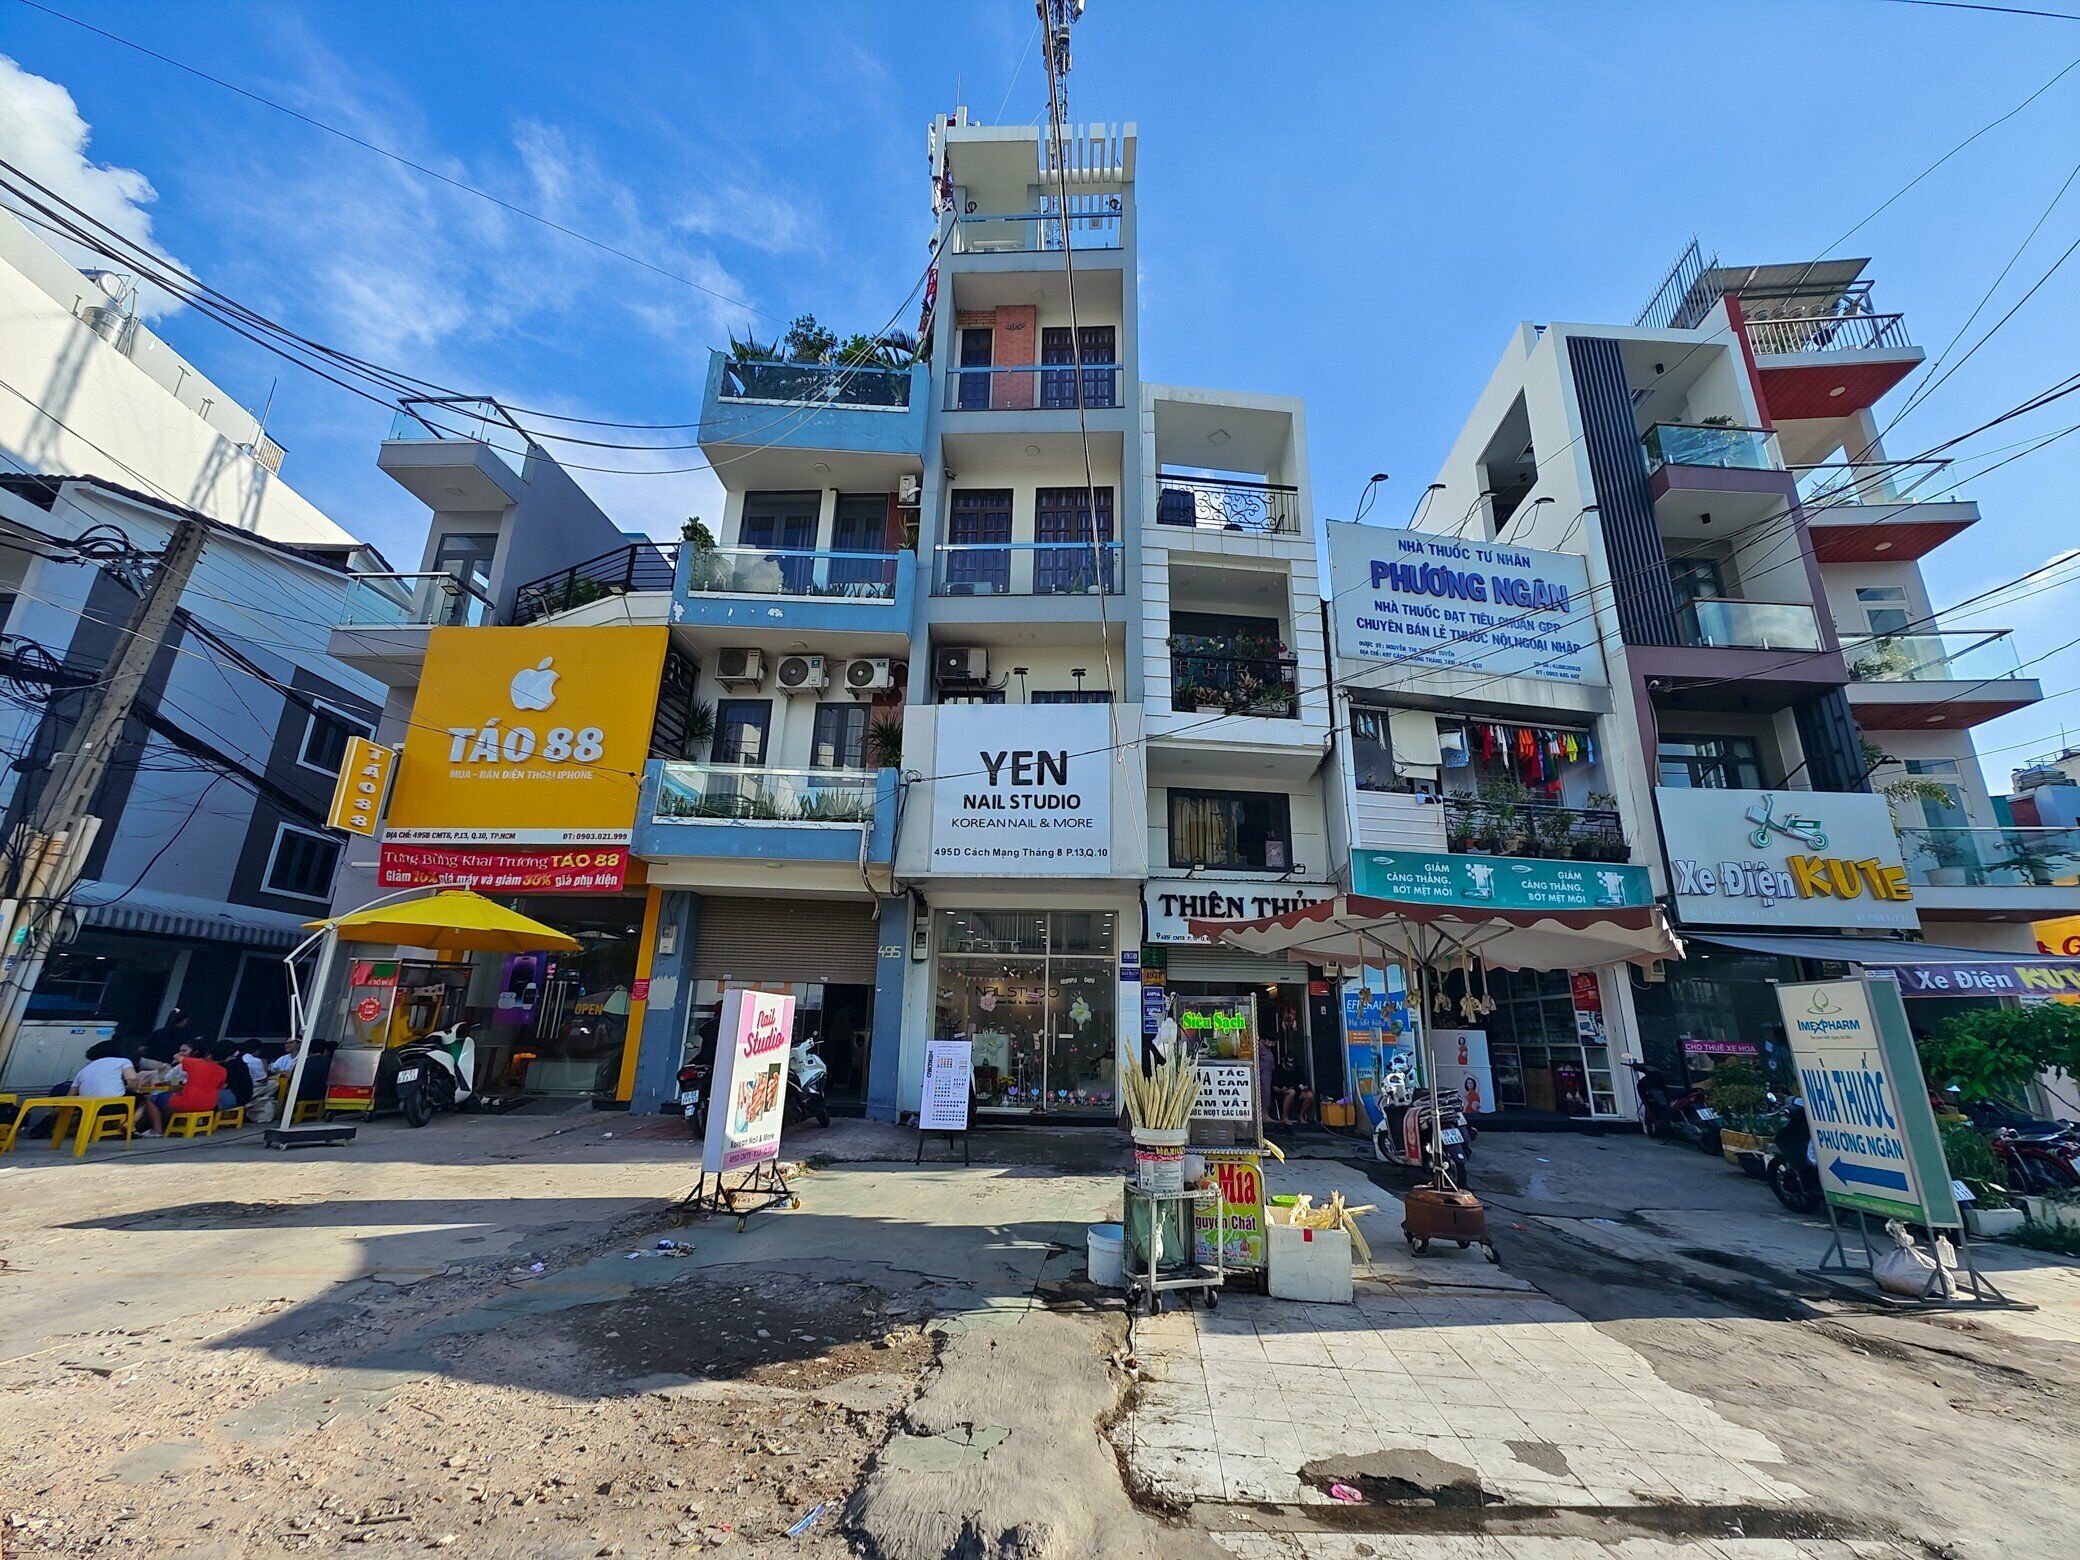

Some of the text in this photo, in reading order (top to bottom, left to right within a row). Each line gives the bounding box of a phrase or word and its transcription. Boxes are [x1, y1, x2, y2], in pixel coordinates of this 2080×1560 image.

[1398, 539, 1531, 568] NHÀ THUỐC TƯ NHÂN
[1370, 560, 1570, 612] PHƯƠNG NGÂN
[1374, 600, 1399, 614] NHÀ
[1402, 603, 1440, 619] THUỐC
[1444, 610, 1466, 624] ĐẠT
[1469, 611, 1494, 625] TIÊU
[1356, 616, 1403, 633] CHUYÊN
[1406, 622, 1430, 637] BÁN
[1433, 624, 1447, 639] LẺ
[448, 717, 604, 763] TÁO 88
[980, 750, 1068, 787] YEN
[963, 794, 1081, 810] NAIL STUDIO
[952, 818, 1093, 828] KOREAN NAIL & MORE
[422, 853, 459, 868] Bừng
[462, 854, 493, 867] Khai
[497, 856, 549, 870] Trương
[551, 853, 591, 868] TÁO
[594, 853, 620, 868] 88
[964, 847, 990, 857] Cách
[993, 848, 1020, 859] Mạng
[1023, 847, 1054, 859] Tháng
[1057, 848, 1063, 857] 8
[1425, 862, 1450, 873] GIẢM
[1557, 869, 1582, 881] GIẢM
[386, 869, 411, 883] Giảm
[481, 875, 493, 885] và
[495, 873, 522, 887] giảm
[555, 875, 572, 887] giá
[574, 874, 592, 888] phụ
[595, 873, 618, 888] kiện
[1672, 854, 1914, 907] Xe Điện KUTE
[1393, 883, 1453, 896] BỚT MỆT MỎI
[1528, 891, 1546, 902] BỚT
[1158, 890, 1245, 919] THIÊN
[878, 945, 902, 958] 495
[1914, 969, 1950, 989] Xe
[1954, 969, 2014, 993] Điện
[574, 1003, 604, 1016] OPEN
[1182, 1011, 1212, 1030] Siêu
[1212, 1010, 1247, 1035] Sạch
[1796, 1019, 1861, 1034] IMEXPHARM
[743, 1026, 785, 1058] Studio
[1685, 1042, 1702, 1051] CHO
[1704, 1043, 1725, 1052] THUÊ
[1217, 1079, 1249, 1087] CAM
[1218, 1087, 1240, 1096] MÁ
[1801, 1051, 1896, 1130] NHÀ THUỐC
[1194, 1099, 1217, 1107] AM
[1222, 1108, 1235, 1117] CÁC
[1236, 1109, 1250, 1117] LOẠI
[1816, 1129, 1905, 1160] PHƯƠNG NGÂN
[1218, 1157, 1257, 1205] Mía
[1232, 1213, 1257, 1231] Chất
